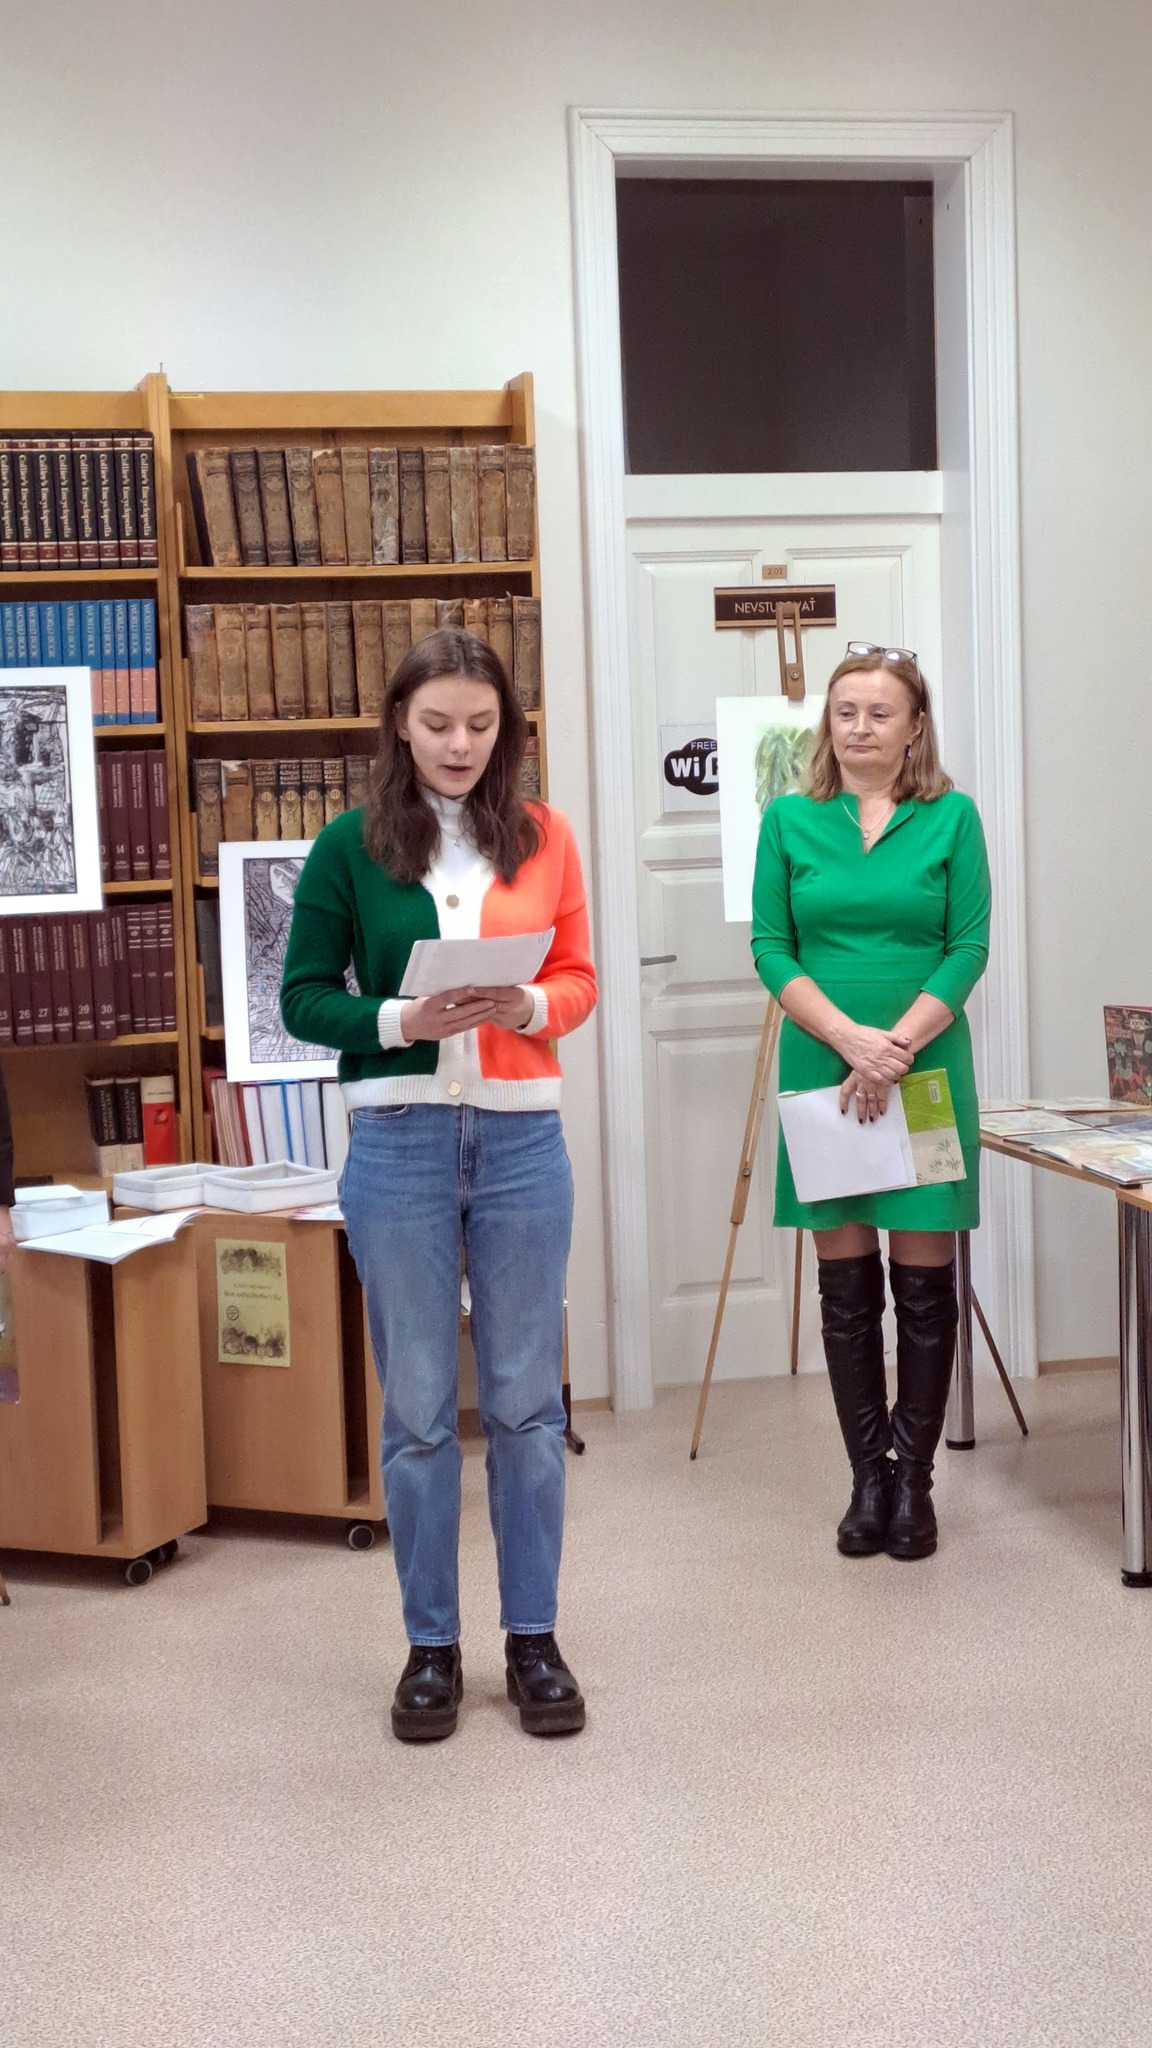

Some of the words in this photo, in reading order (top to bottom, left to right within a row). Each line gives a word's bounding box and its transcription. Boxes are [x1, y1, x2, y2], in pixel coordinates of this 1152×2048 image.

[0, 488, 13, 539] Encyclopedia
[19, 488, 32, 539] Encyclopedia
[39, 488, 52, 538] Encyclopedia
[60, 488, 71, 538] Encyclopedia
[80, 487, 92, 537] Encyclopedia
[100, 487, 112, 537] Encyclopedia
[121, 486, 132, 536] Encyclopedia
[140, 486, 151, 536] Encyclopedia
[691, 740, 717, 750] FREE
[136, 845, 145, 854] 15
[19, 1010, 30, 1019] 26
[38, 1008, 48, 1018] 27
[58, 1007, 69, 1016] 28
[79, 1004, 90, 1014] 29
[101, 1004, 112, 1014] 30
